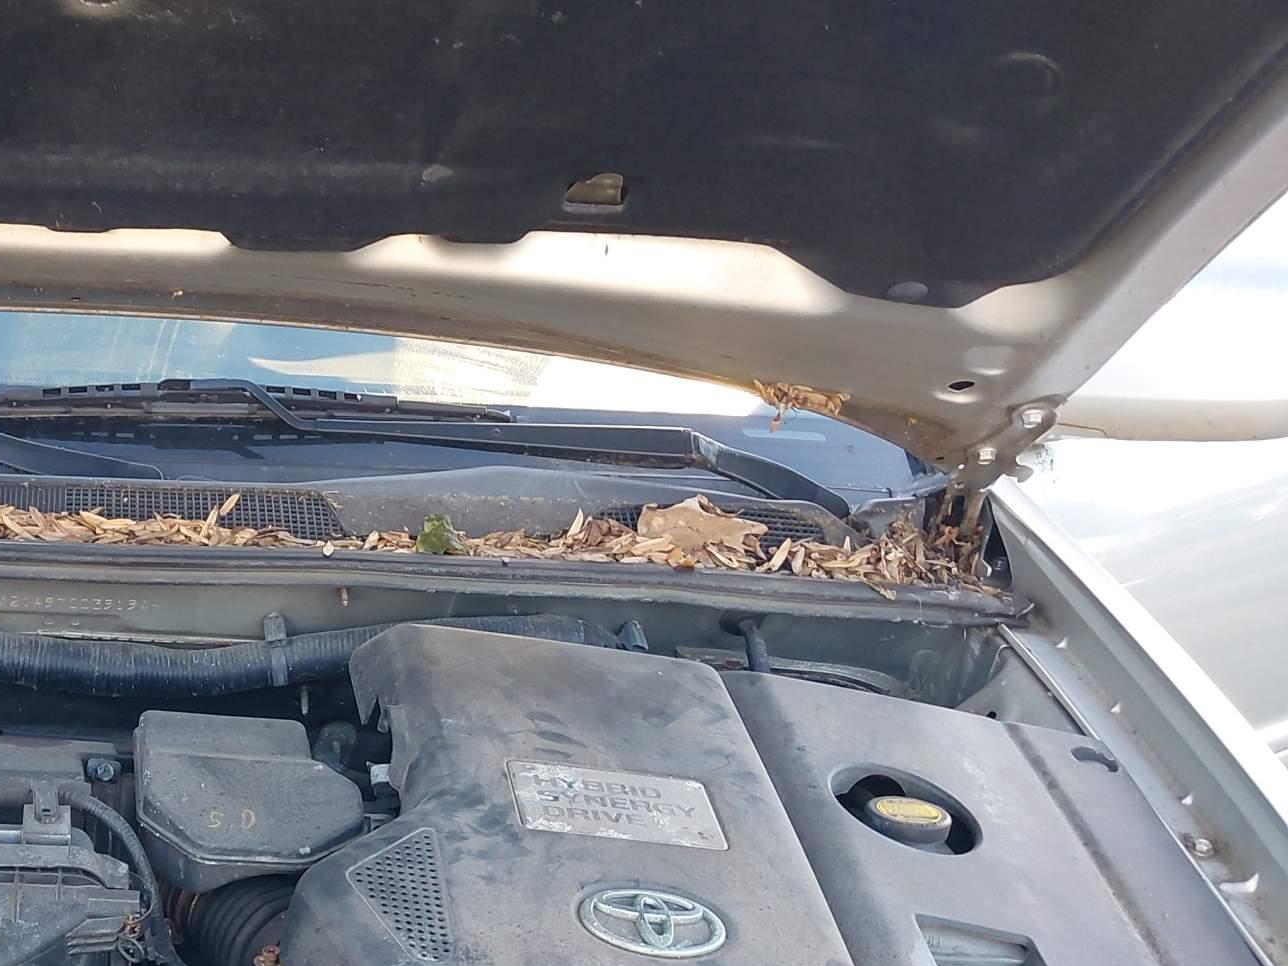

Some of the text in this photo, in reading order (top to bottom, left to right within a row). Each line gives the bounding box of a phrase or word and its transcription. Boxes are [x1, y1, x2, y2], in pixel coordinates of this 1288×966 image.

[534, 775, 661, 799] HYBRID
[536, 789, 696, 818] SYNERGY
[544, 806, 649, 827] DRIVE
